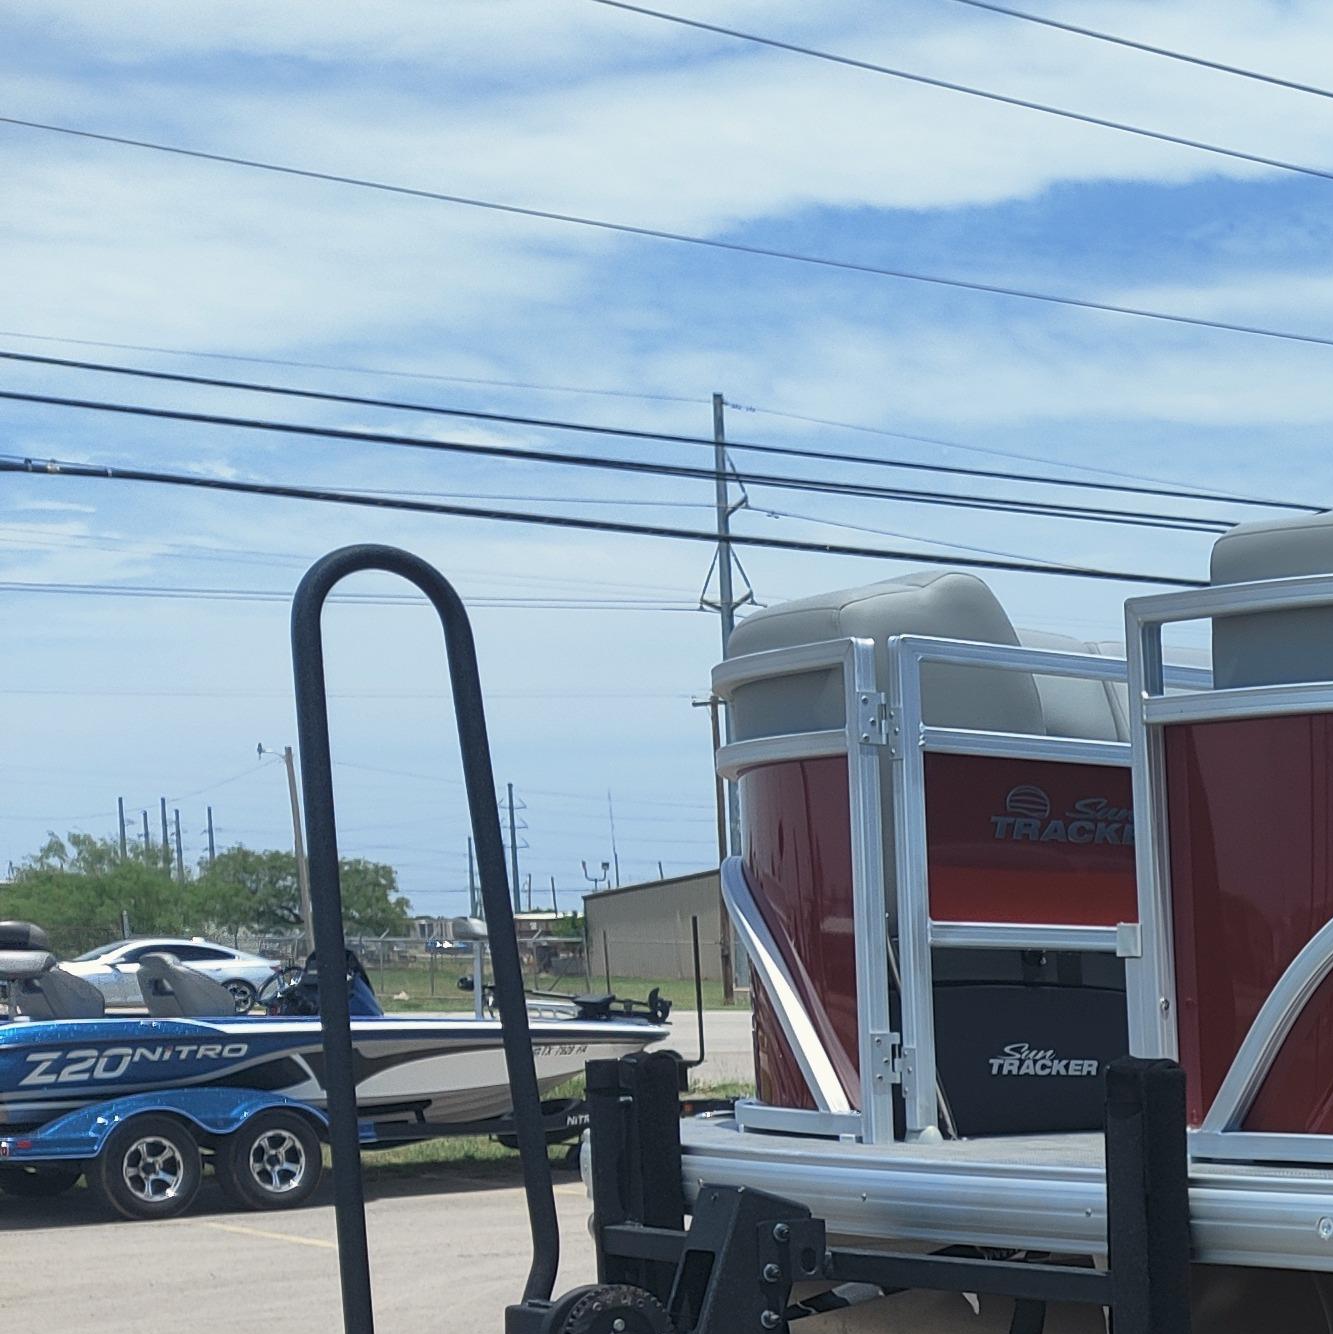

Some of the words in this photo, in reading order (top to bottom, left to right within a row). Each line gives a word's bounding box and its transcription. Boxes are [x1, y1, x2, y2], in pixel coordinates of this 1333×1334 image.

[998, 1043, 1056, 1061] Sun
[18, 1047, 133, 1087] Z20
[132, 1042, 249, 1062] NITRO
[989, 1058, 1098, 1076] TRACKER
